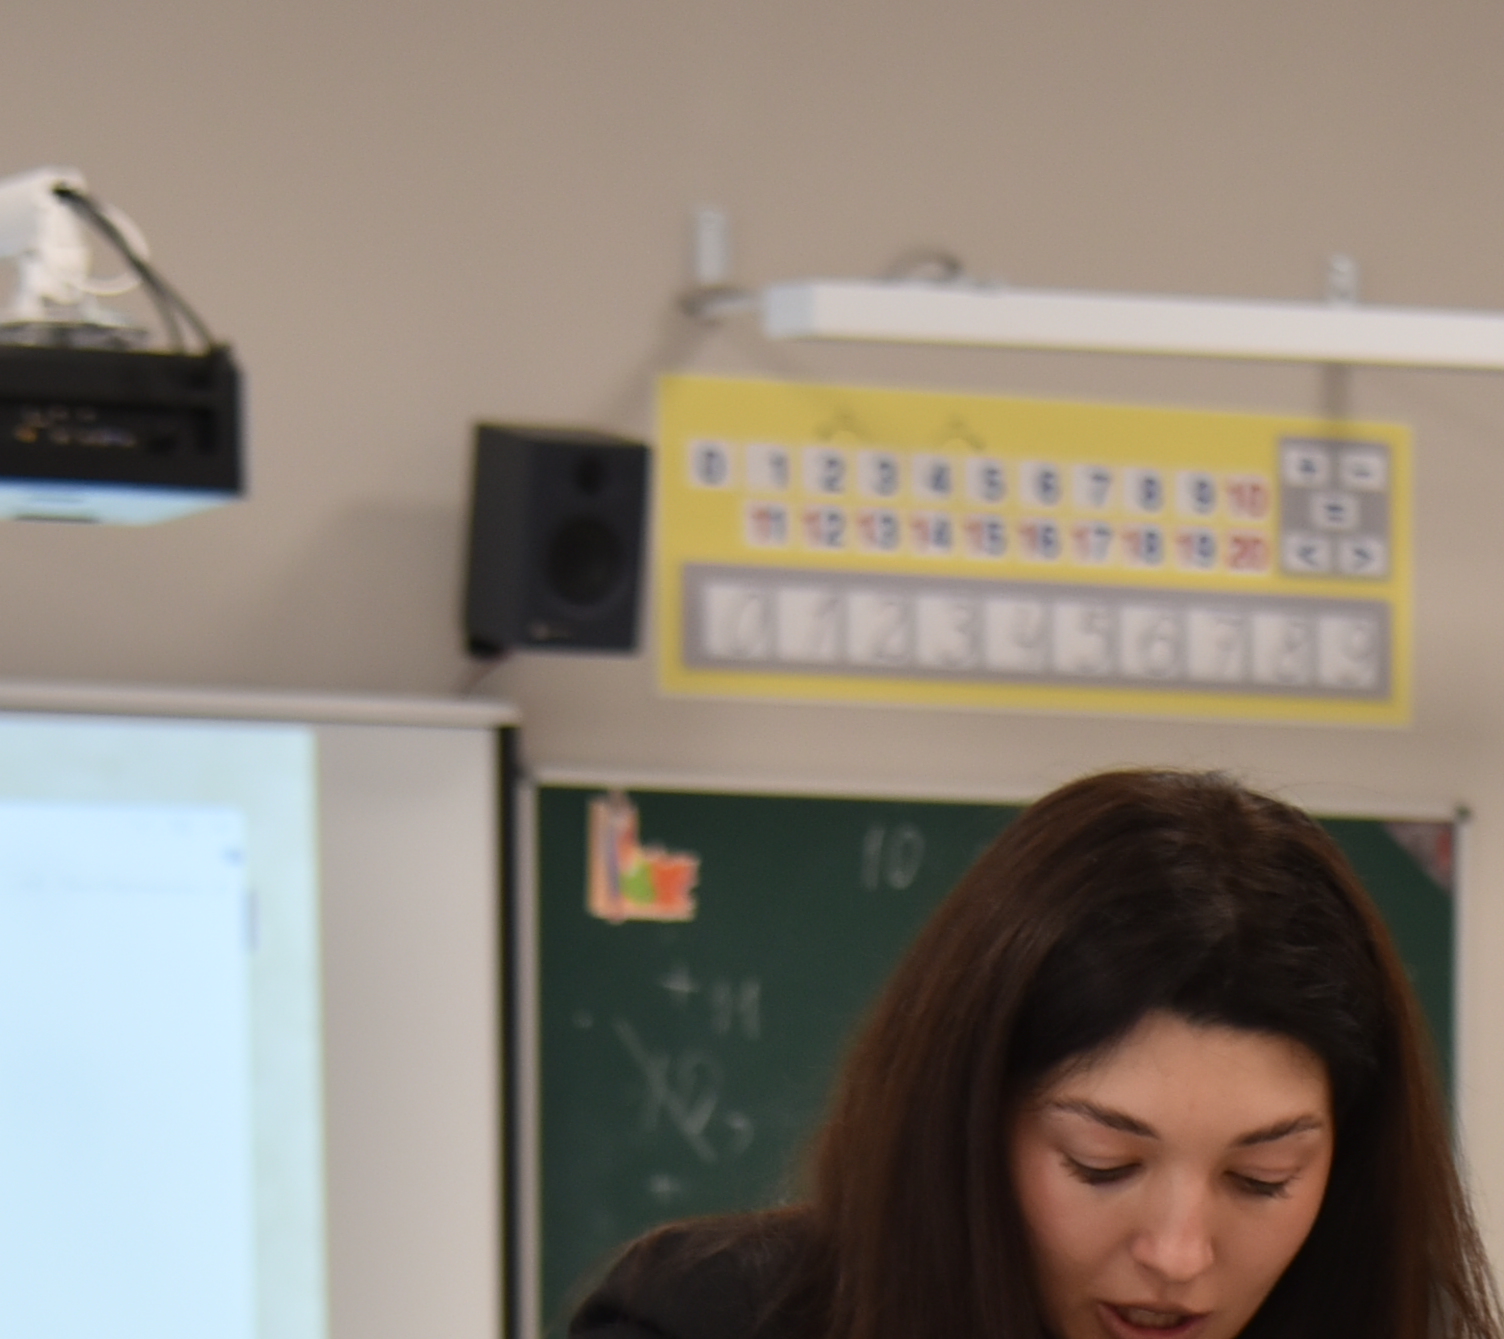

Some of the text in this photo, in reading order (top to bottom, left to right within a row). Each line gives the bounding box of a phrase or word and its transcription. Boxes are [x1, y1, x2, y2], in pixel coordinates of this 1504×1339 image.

[696, 445, 728, 486] 0
[819, 455, 845, 495] 2
[872, 457, 899, 498] 3
[924, 459, 952, 497] 4
[980, 465, 1006, 504] 5
[1034, 467, 1062, 507] 6
[1090, 469, 1114, 511] 7
[1139, 473, 1165, 514] 8
[1191, 476, 1217, 517] 9
[1225, 478, 1272, 521] 10
[750, 507, 1272, 575] 11 12 13 14 15 16 17 18 19 20
[860, 821, 927, 892] 10
